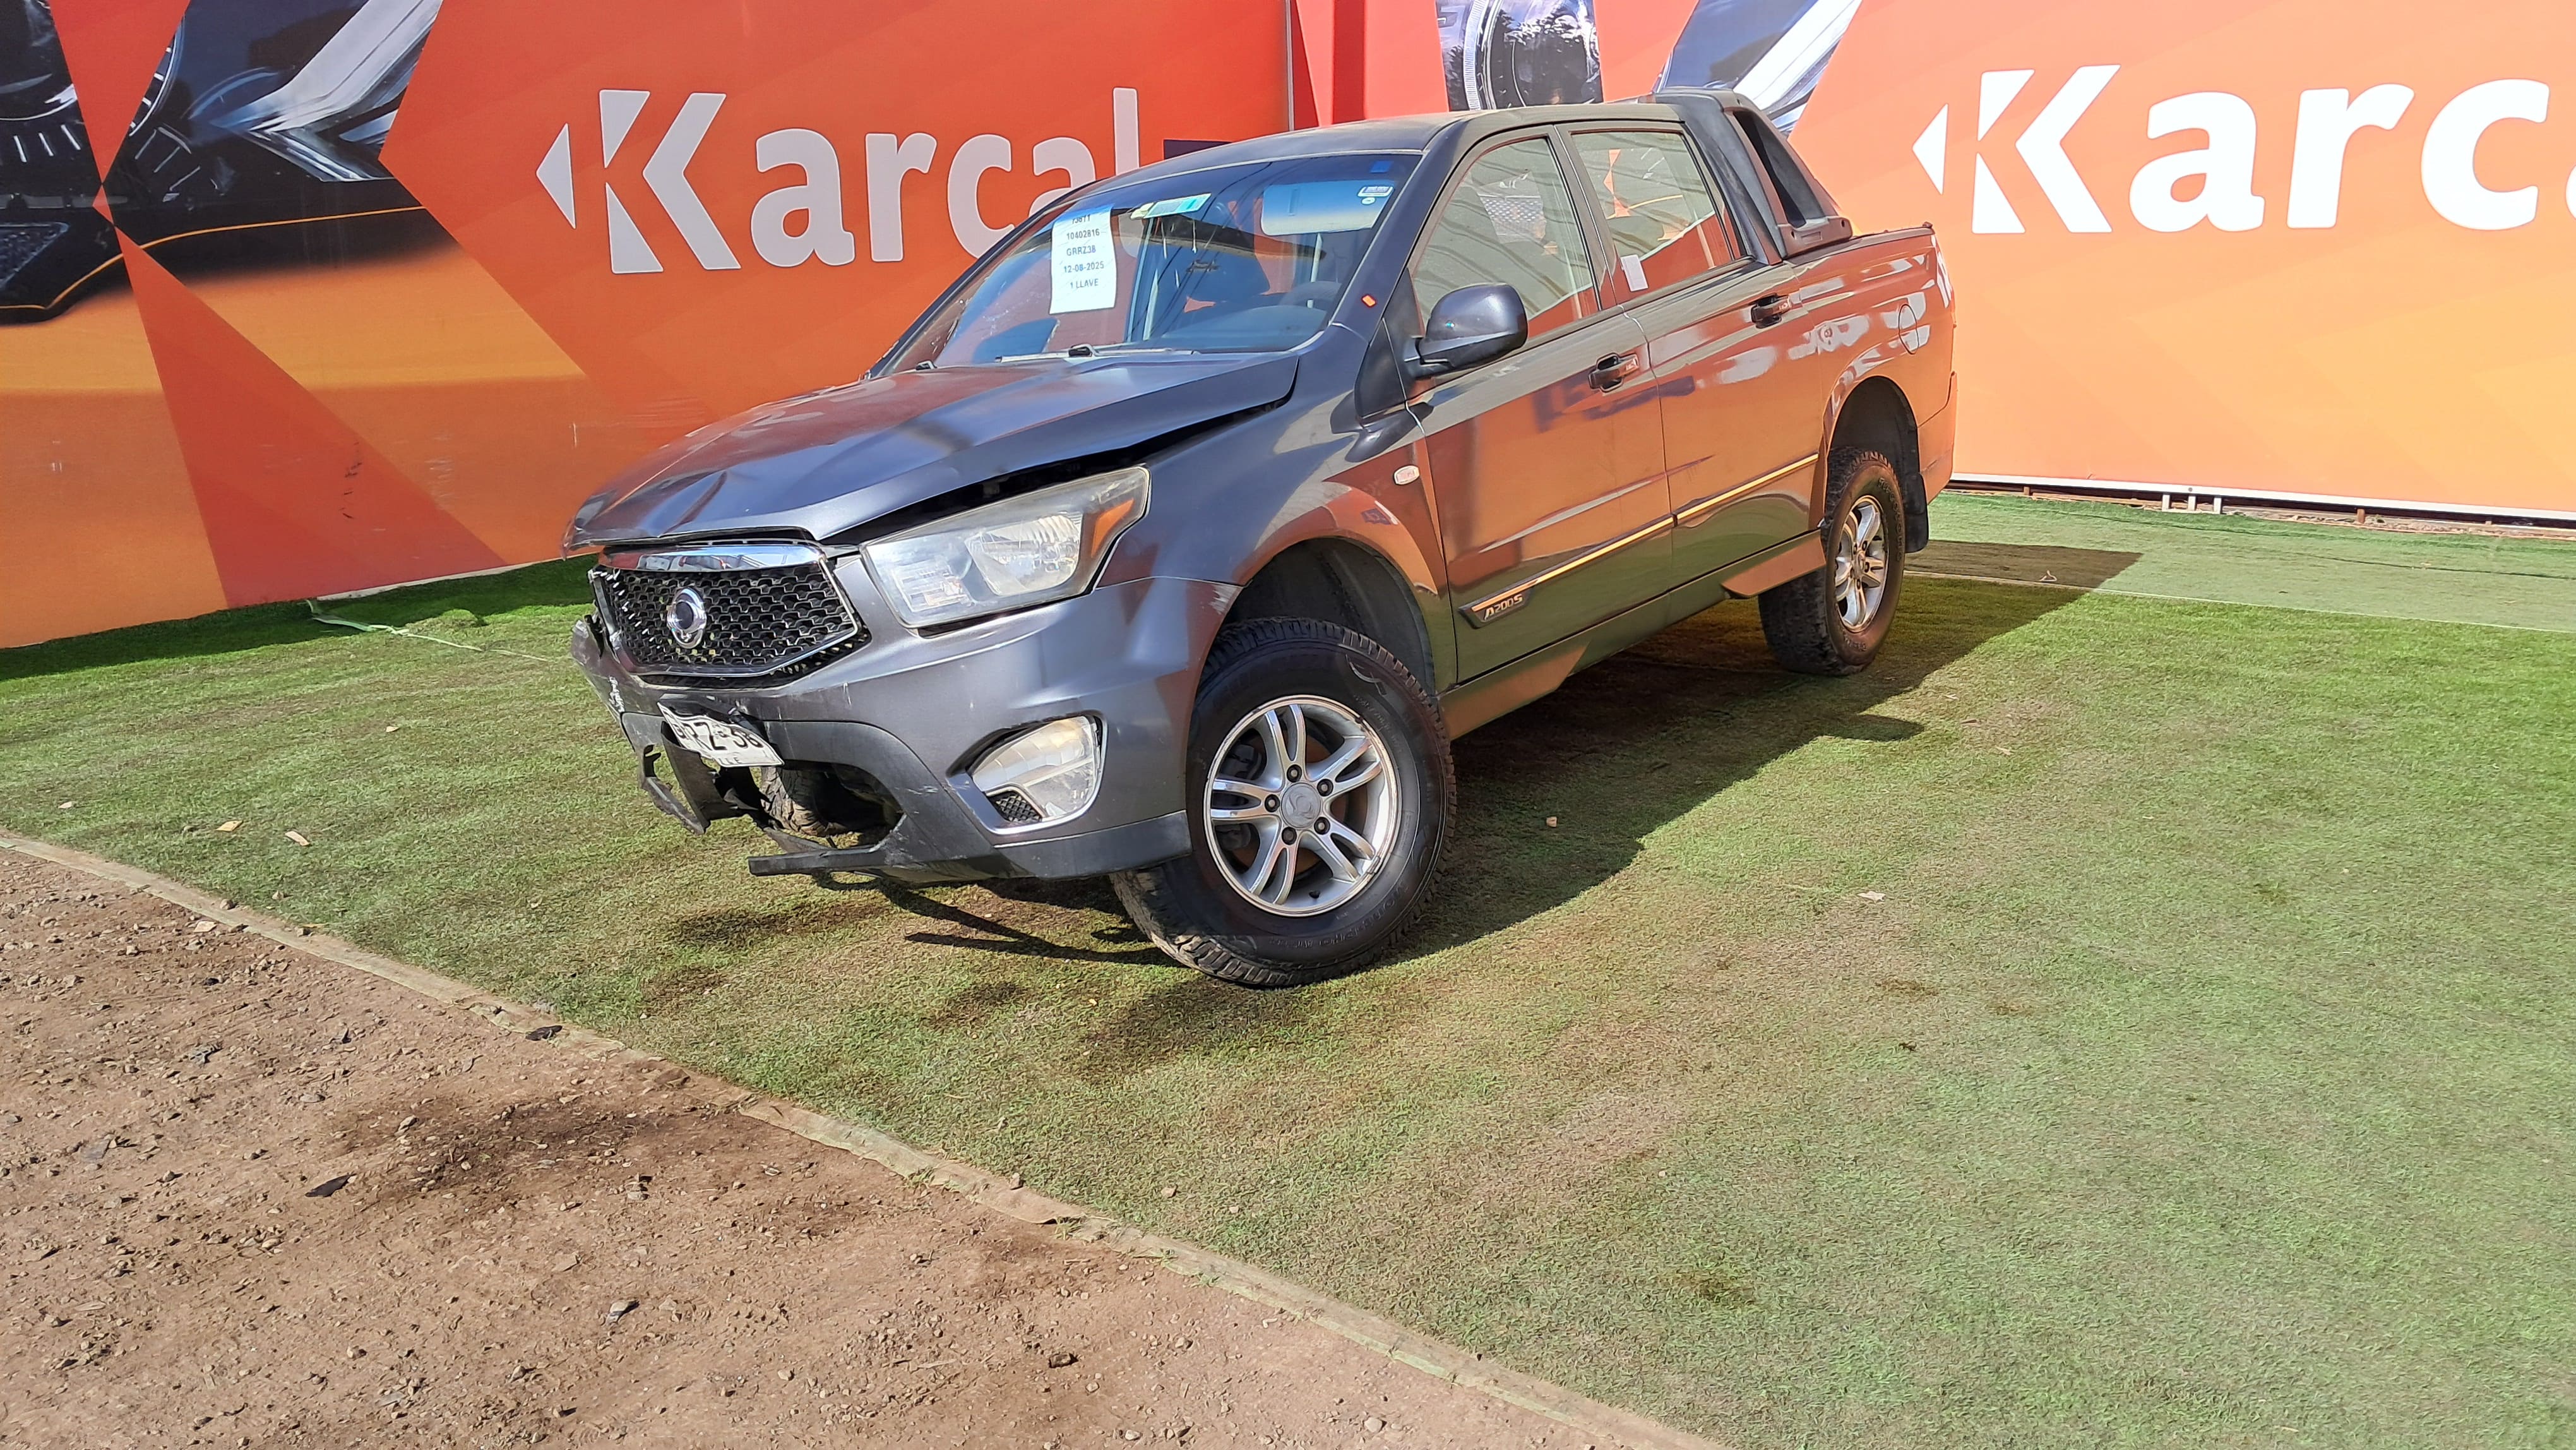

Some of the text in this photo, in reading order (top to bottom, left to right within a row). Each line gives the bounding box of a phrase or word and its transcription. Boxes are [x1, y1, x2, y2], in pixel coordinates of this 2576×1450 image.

[1972, 64, 2576, 234] Karc
[1066, 228, 1100, 240] 10402816
[1063, 261, 1104, 273] 12-08-2025
[1075, 279, 1099, 289] LLAVE
[1484, 594, 1523, 621] A200S
